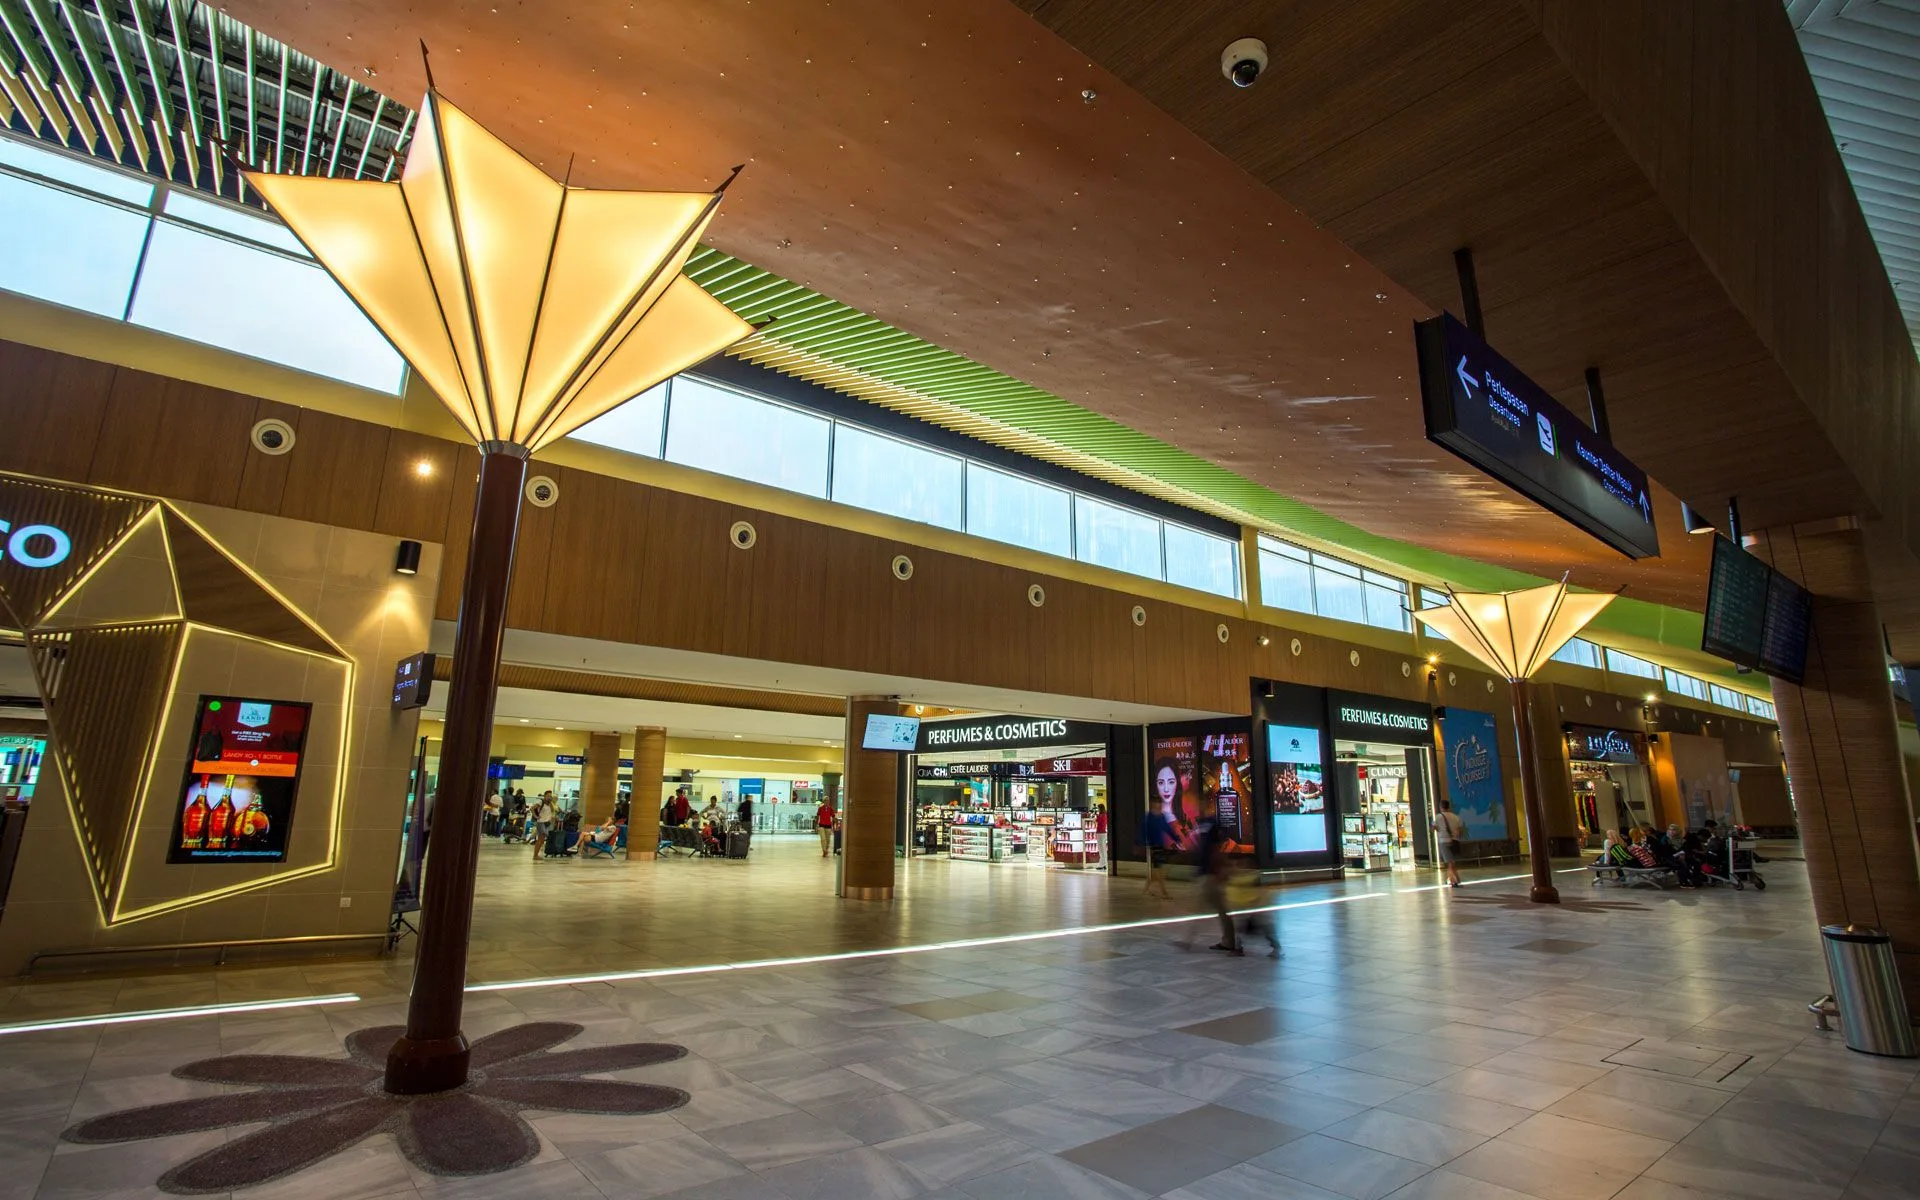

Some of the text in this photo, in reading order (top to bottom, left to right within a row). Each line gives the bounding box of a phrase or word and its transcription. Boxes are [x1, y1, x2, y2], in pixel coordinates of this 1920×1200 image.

[1485, 370, 1529, 417] Perlepasan
[1488, 394, 1521, 427] Departures
[1341, 707, 1428, 731] PERFUMES & COSMETICS
[928, 719, 1067, 745] PERFUMES & COSMETICS
[223, 751, 242, 759] LANDY
[1053, 759, 1071, 772] SK-II
[966, 764, 989, 774] LAUDER
